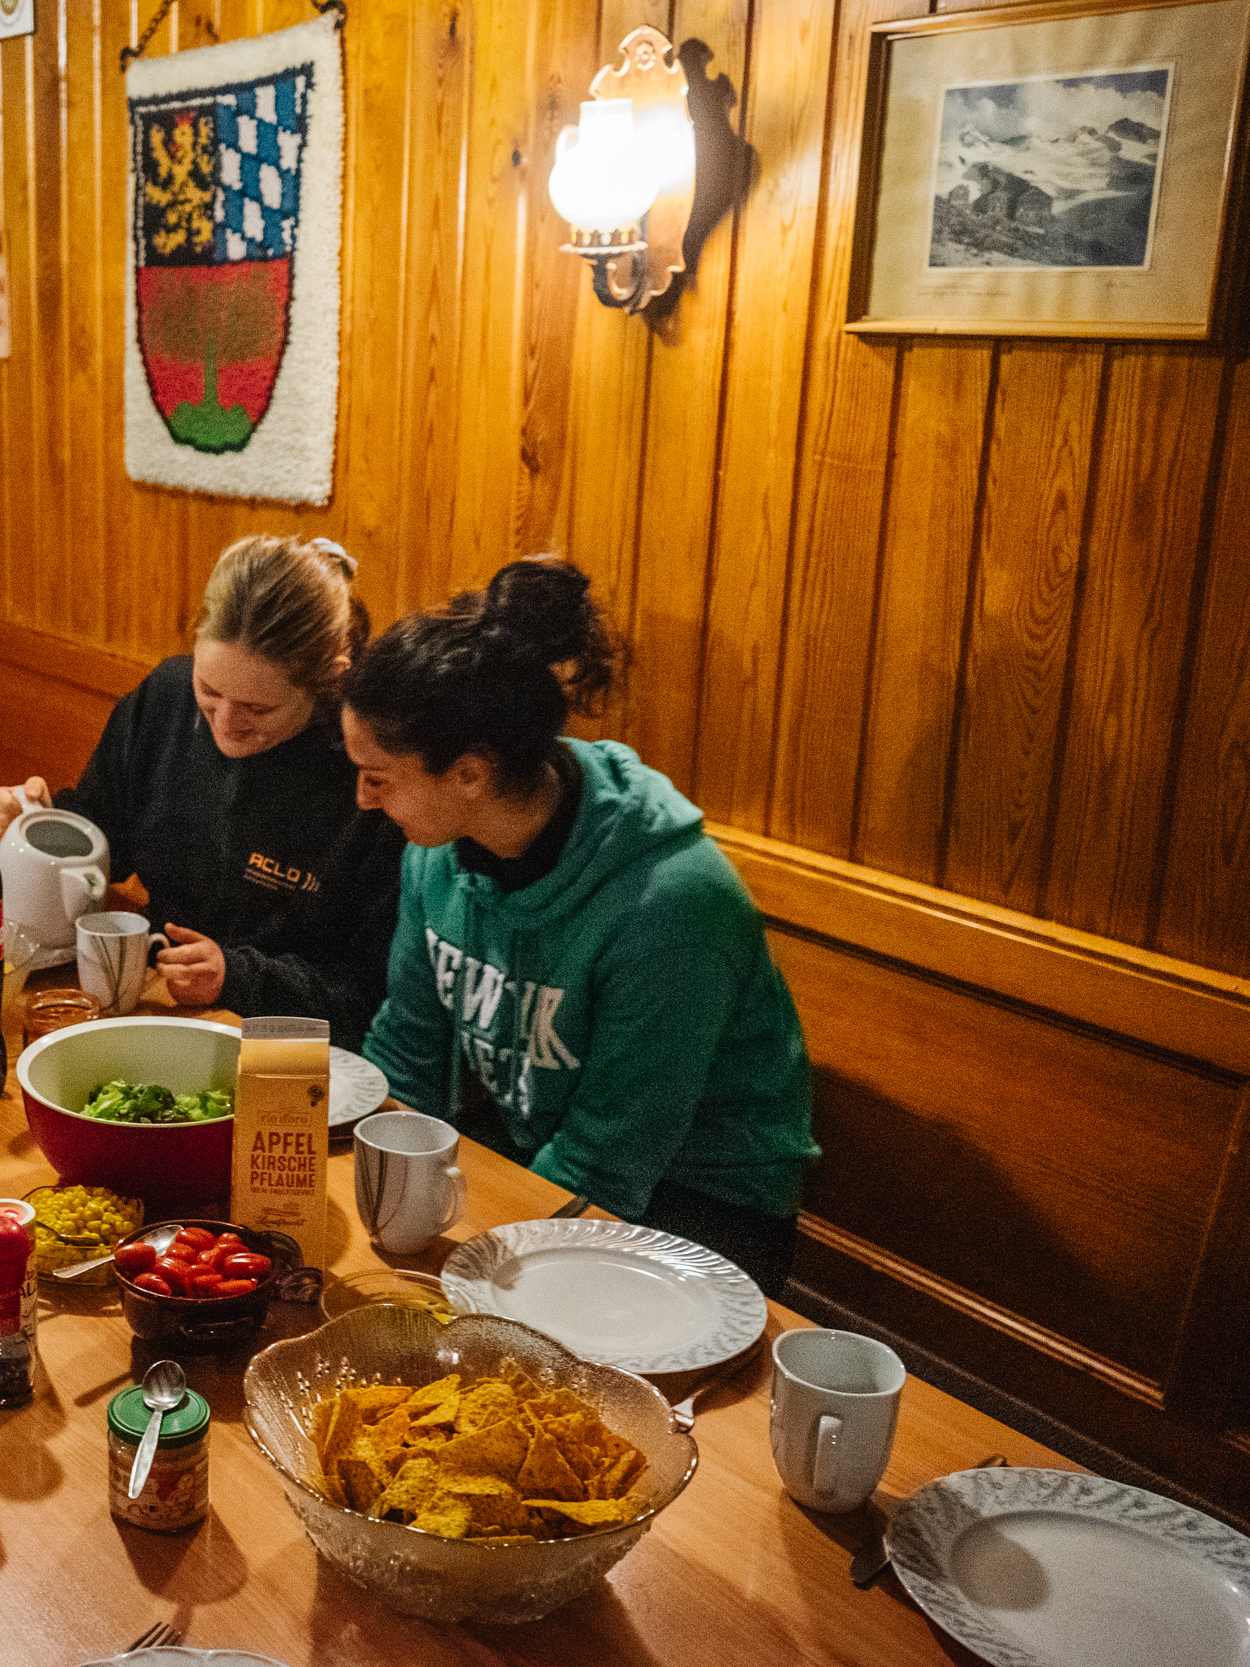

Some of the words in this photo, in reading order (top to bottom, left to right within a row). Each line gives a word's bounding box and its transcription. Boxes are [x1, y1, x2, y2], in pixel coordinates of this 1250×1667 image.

[252, 1130, 316, 1154] APFEL
[250, 1154, 316, 1173] KIRSCHE
[250, 1170, 316, 1188] PFLAUME
